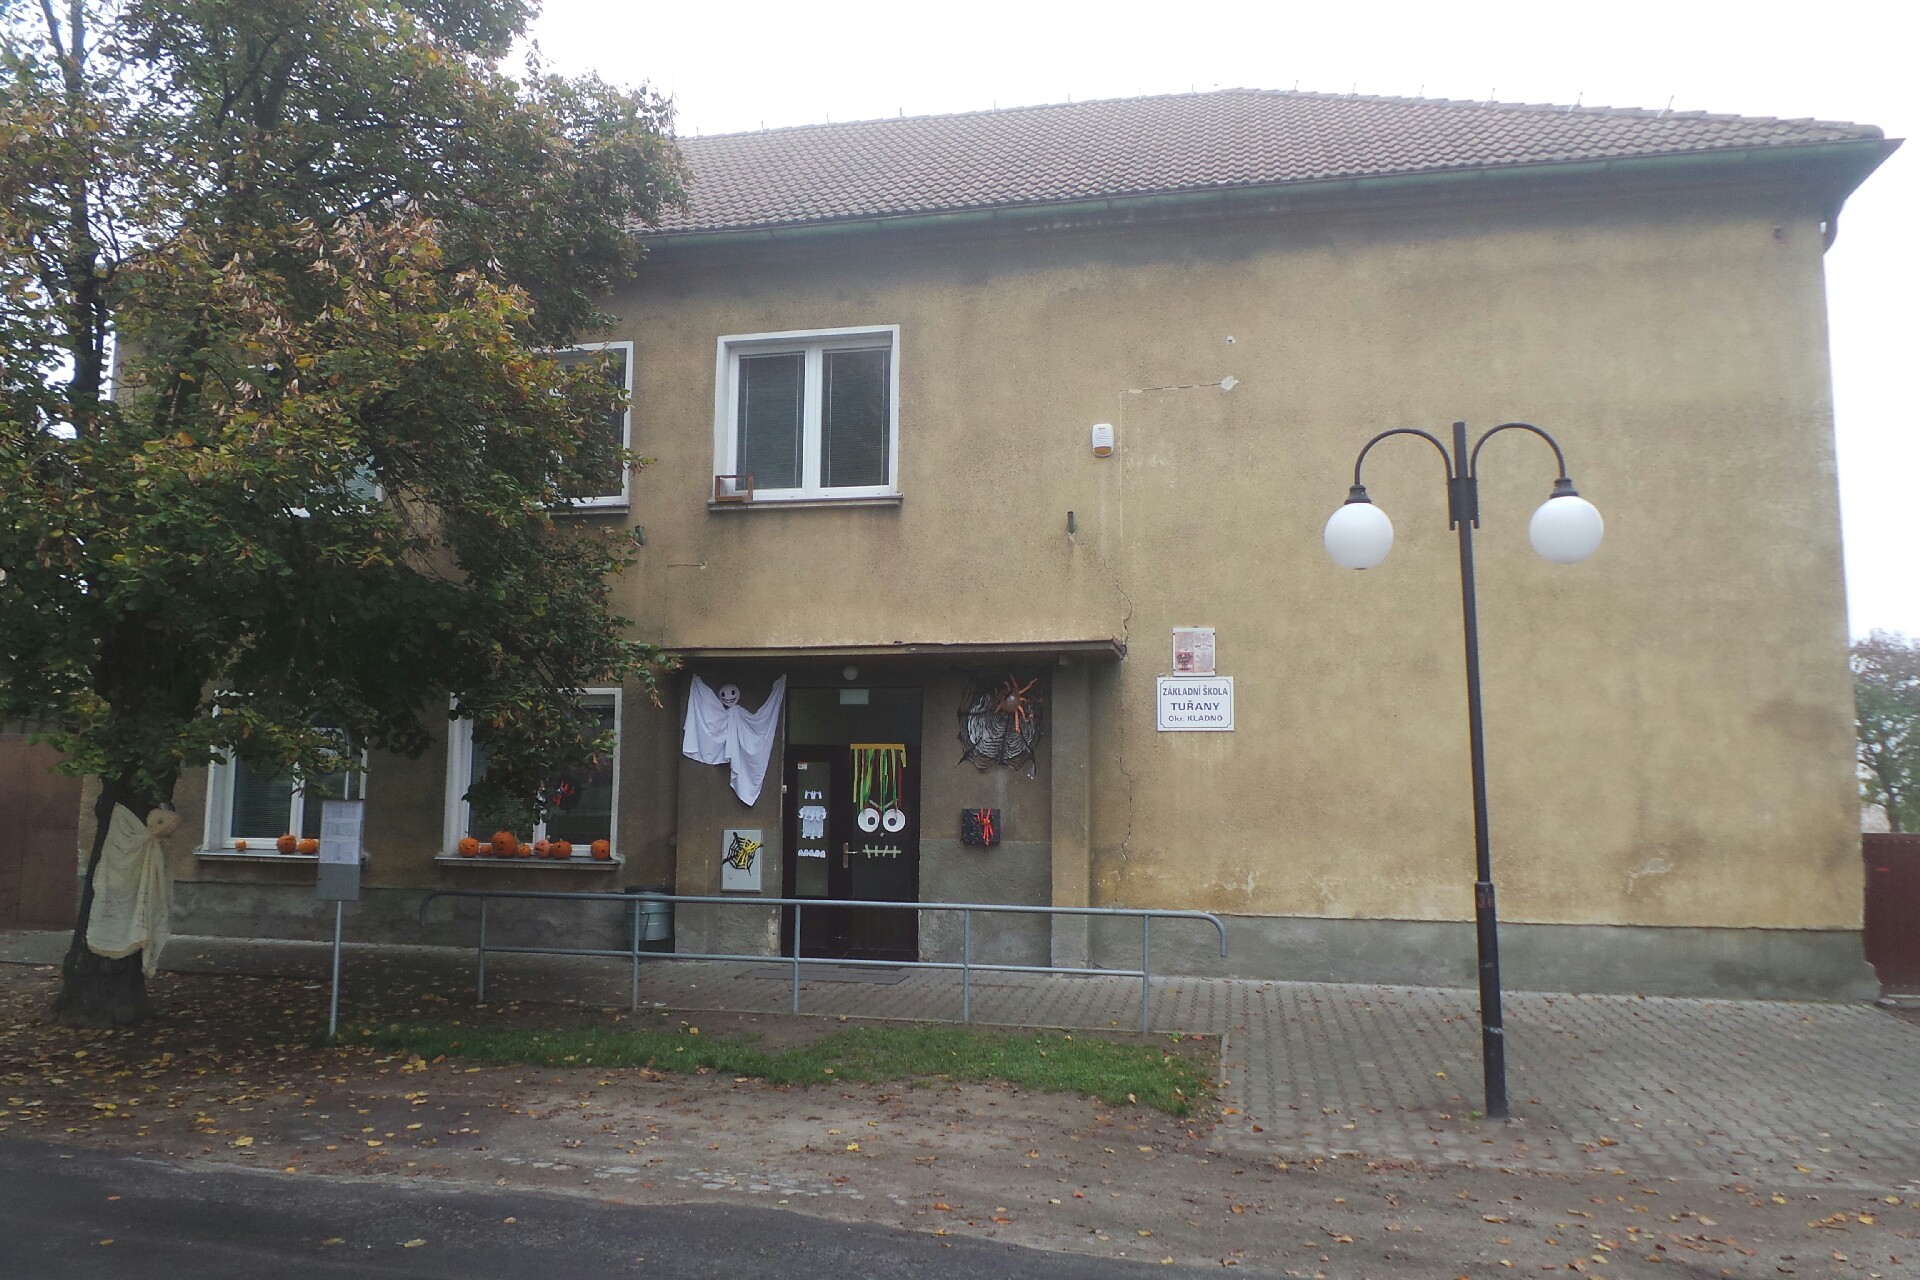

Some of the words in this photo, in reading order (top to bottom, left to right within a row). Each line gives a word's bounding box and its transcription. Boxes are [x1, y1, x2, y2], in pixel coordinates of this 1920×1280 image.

[1163, 685, 1201, 695] ZÁKLADNÍ
[1203, 685, 1228, 695] ŠKOLA
[1170, 700, 1220, 711] TUŘANY
